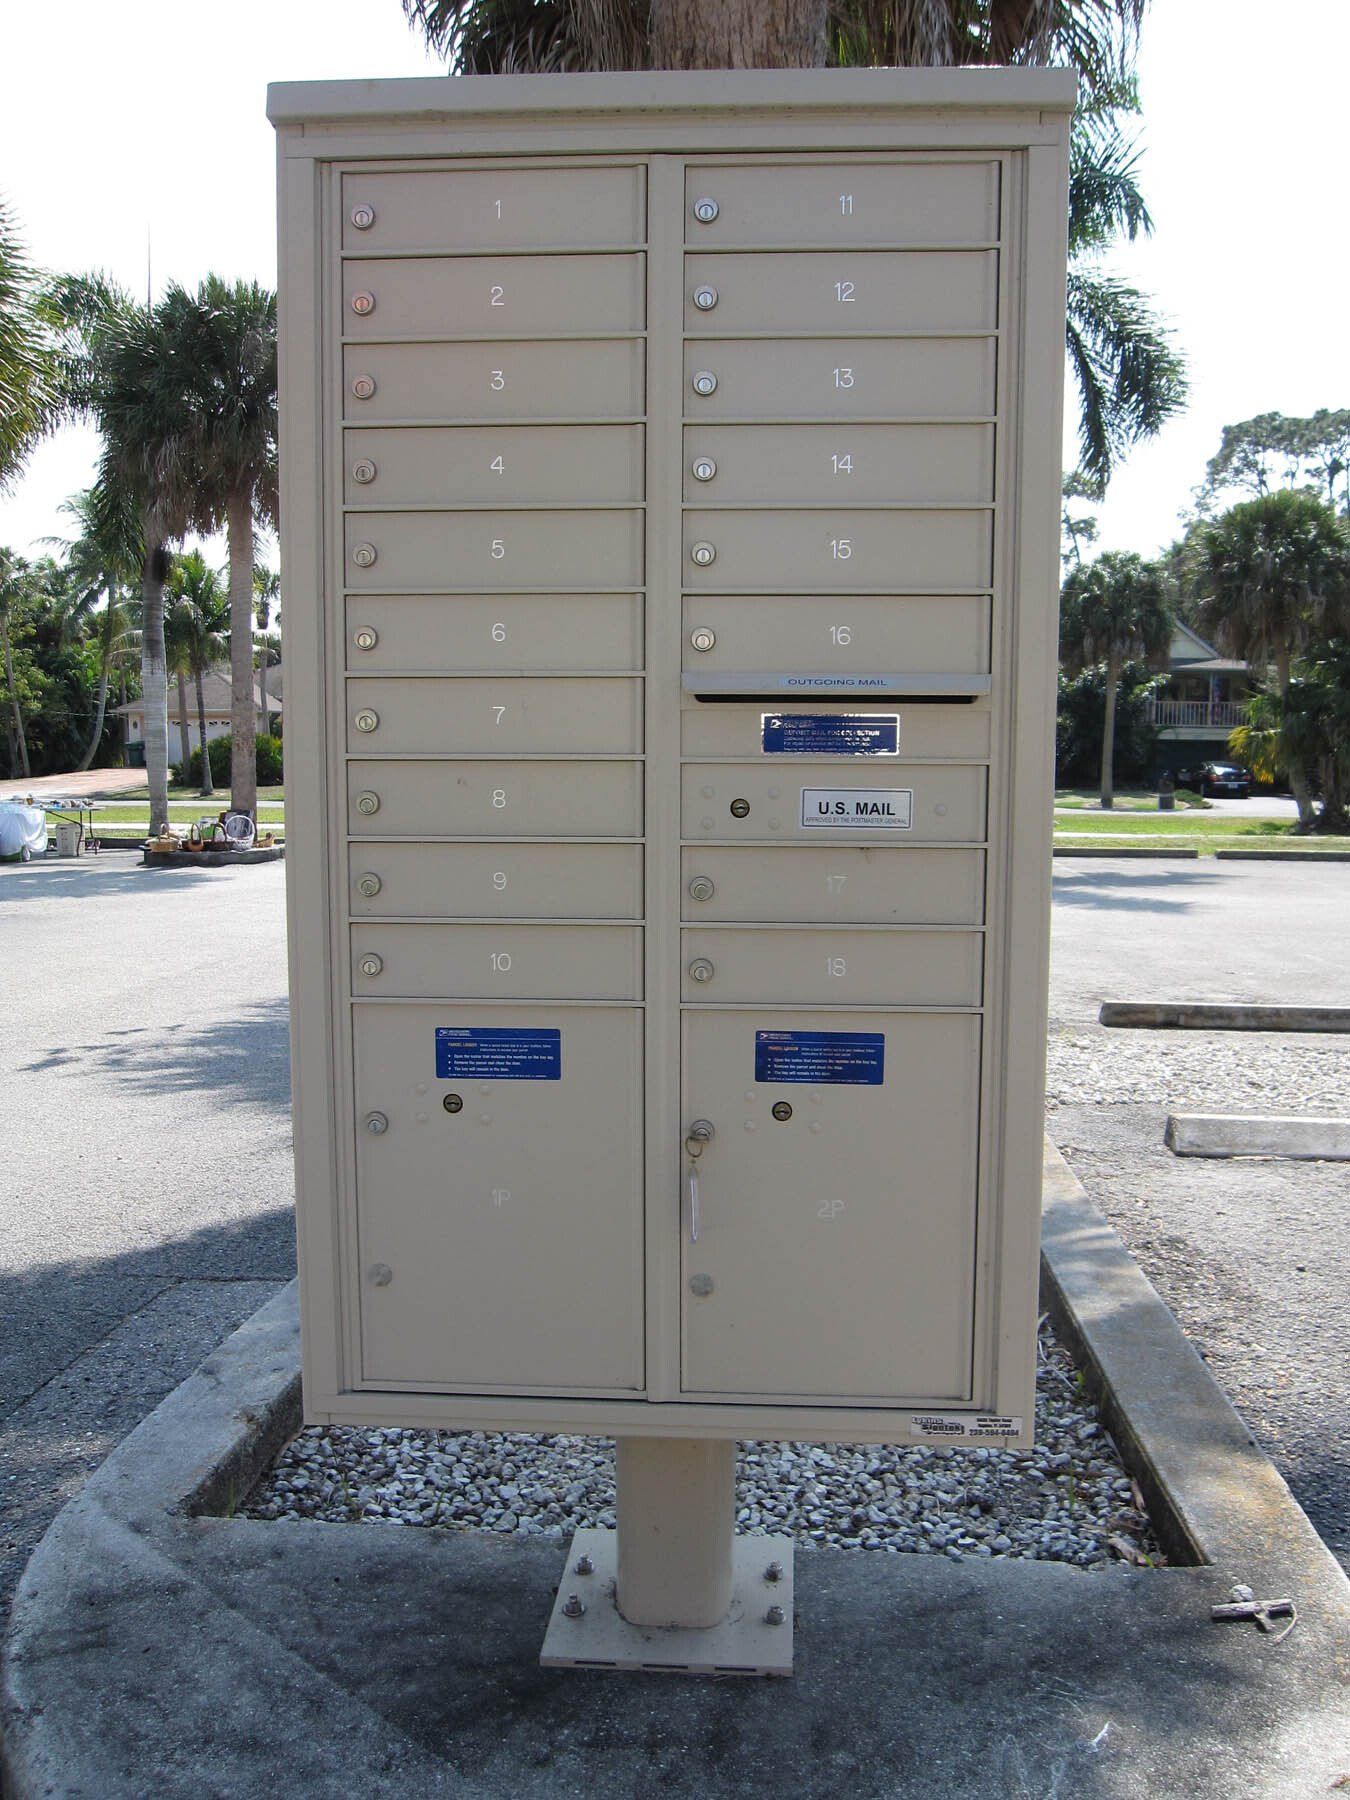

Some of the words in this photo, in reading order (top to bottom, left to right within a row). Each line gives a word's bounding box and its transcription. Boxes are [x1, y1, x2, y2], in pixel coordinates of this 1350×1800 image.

[495, 200, 501, 219] 1
[840, 195, 853, 215] 11
[491, 286, 504, 305] 2
[834, 282, 855, 301] 12
[491, 370, 504, 390] 3
[833, 368, 854, 388] 13
[491, 456, 504, 475] 4
[832, 455, 853, 474] 14
[491, 539, 504, 559] 5
[830, 540, 851, 559] 15
[491, 622, 505, 642] 6
[830, 625, 850, 645] 16
[491, 706, 505, 725] 7
[492, 789, 506, 808] 8
[819, 802, 850, 815] U.S.
[855, 803, 896, 815] MAIL
[493, 871, 507, 890] 9
[827, 876, 847, 893] 17
[490, 953, 511, 972] 10
[827, 958, 846, 976] 18
[491, 1189, 510, 1207] 1P
[818, 1200, 844, 1217] 2P
